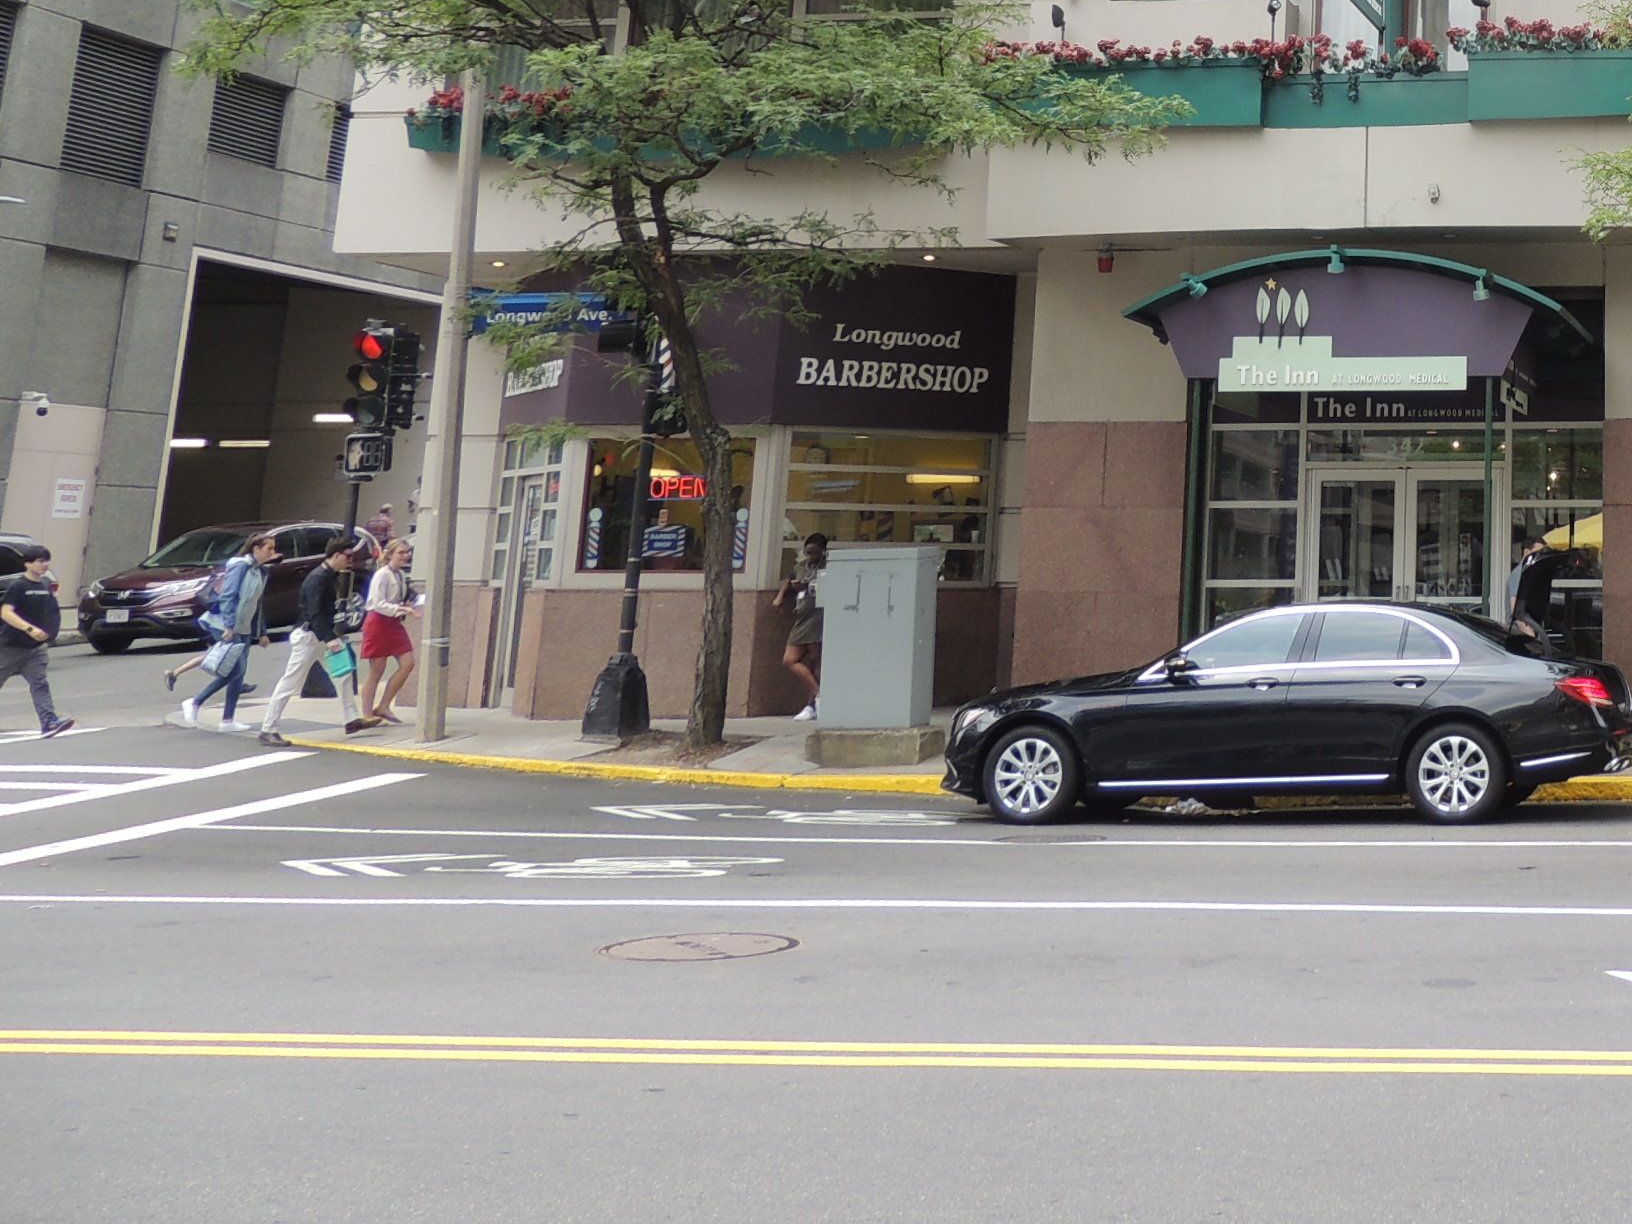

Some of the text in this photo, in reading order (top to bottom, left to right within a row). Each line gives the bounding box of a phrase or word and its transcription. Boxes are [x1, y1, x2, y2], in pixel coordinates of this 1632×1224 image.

[486, 308, 613, 326] Longwd Ave.
[832, 323, 962, 350] Longwood
[796, 356, 989, 393] BARBERSHOP
[1237, 364, 1449, 386] The Inn AT LONGWOOD MEDICAL
[1313, 397, 1357, 418] The
[1365, 397, 1405, 418] Inn
[1417, 408, 1462, 418] LONGWOOD
[1464, 408, 1499, 418] MEDIAL
[650, 476, 706, 499] OPEN
